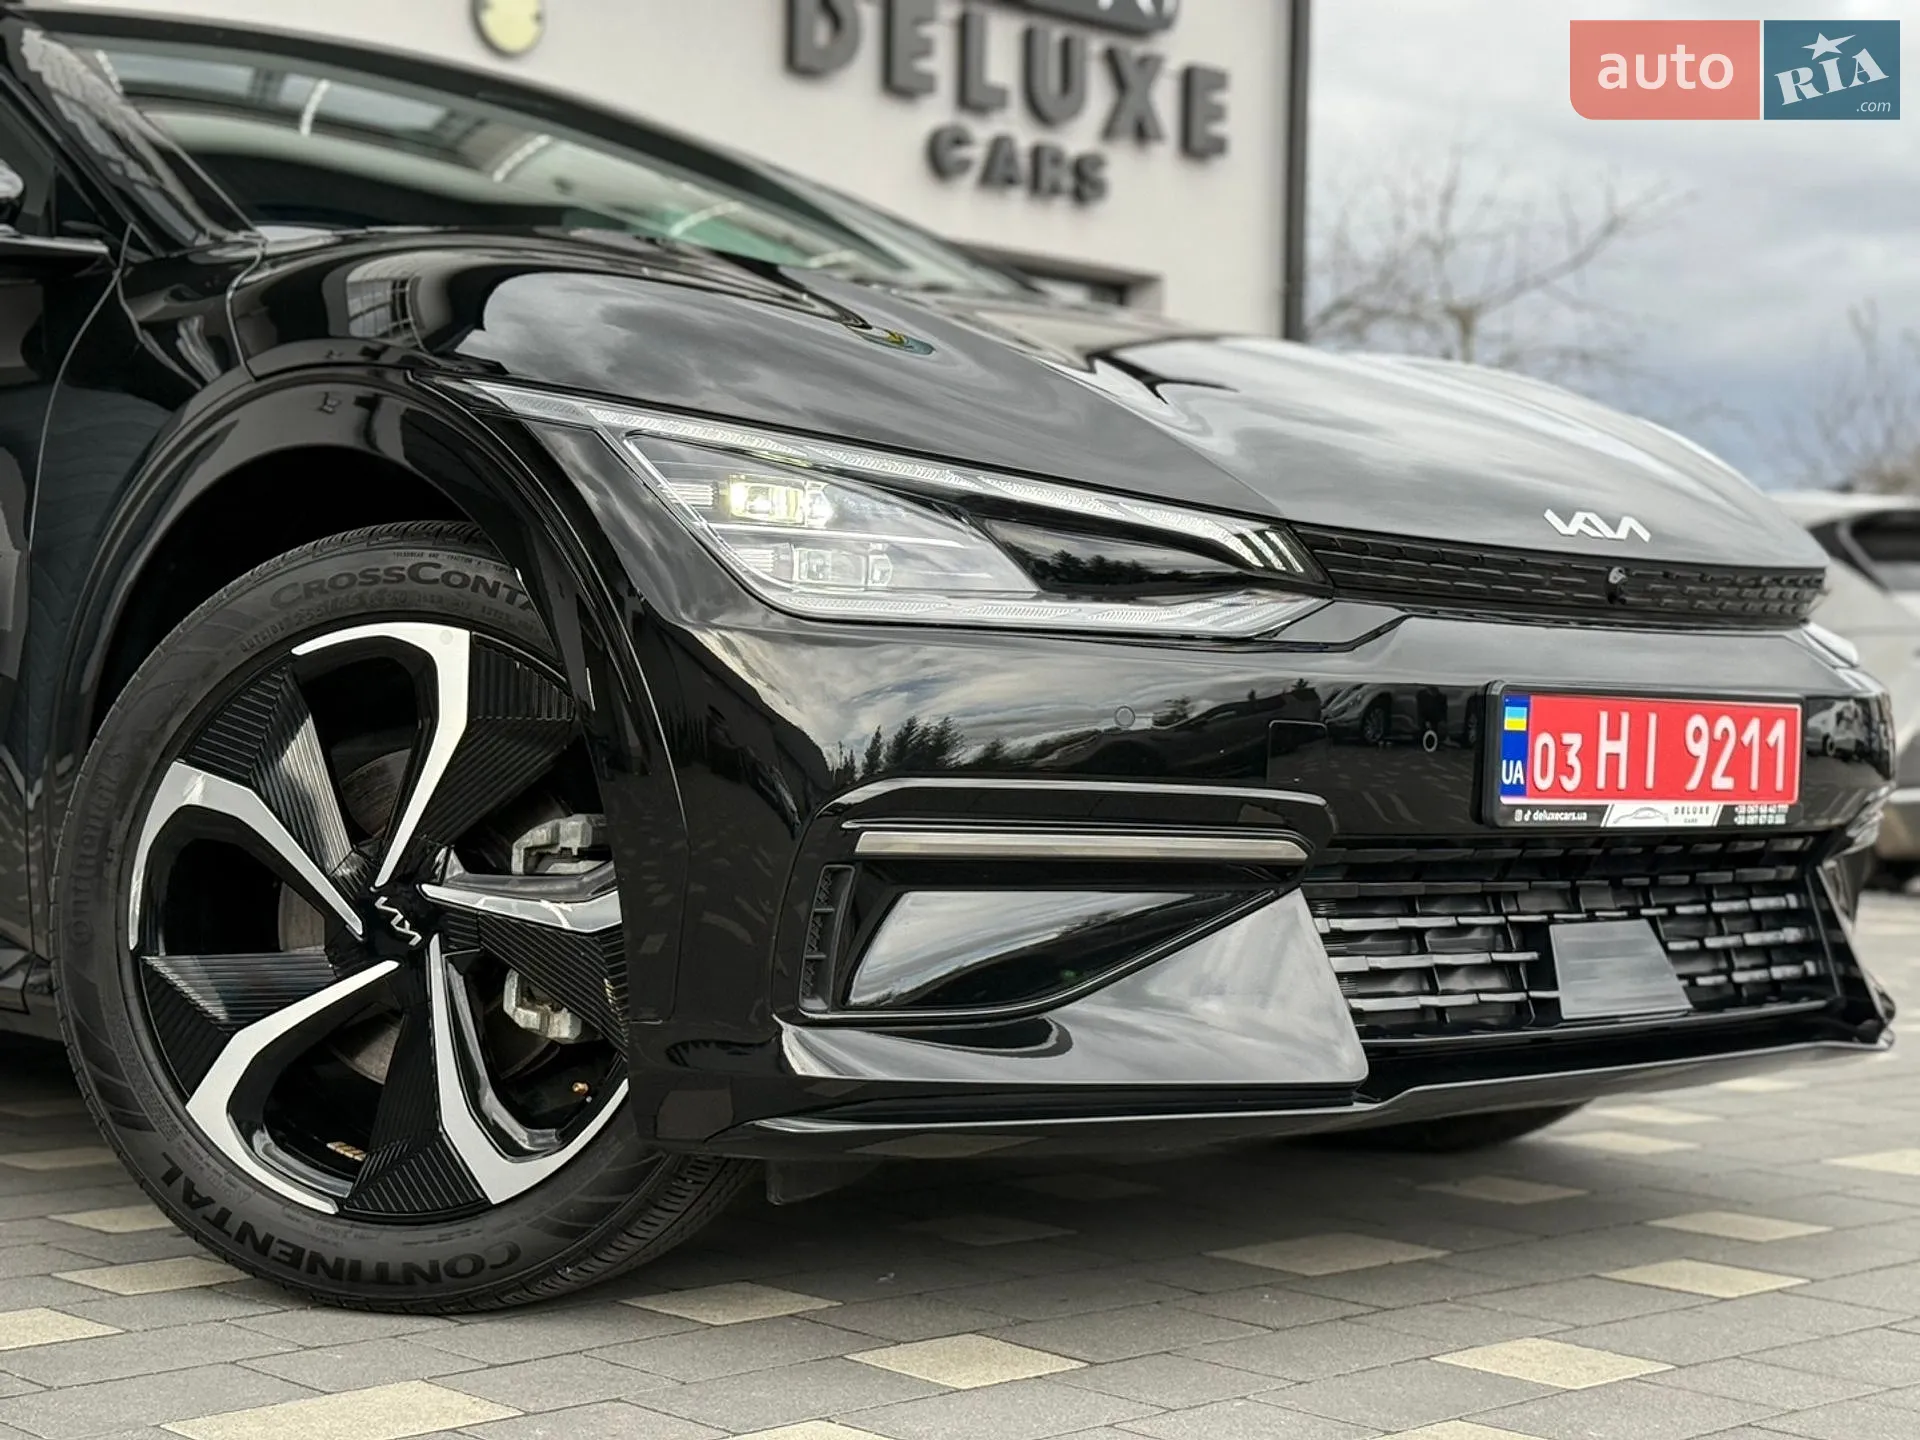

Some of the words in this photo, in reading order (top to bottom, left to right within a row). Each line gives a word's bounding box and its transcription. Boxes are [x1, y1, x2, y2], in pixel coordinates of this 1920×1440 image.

[785, 0, 1230, 161] DELUXE
[924, 123, 1109, 206] CARS
[1543, 508, 1652, 543] KIA
[1502, 759, 1524, 785] UA
[1533, 731, 1583, 792] 03
[1596, 710, 1658, 790] HI
[1684, 713, 1787, 792] 9211
[1674, 805, 1710, 815] DELUXE
[161, 1151, 523, 1285] CONTINENTAL
